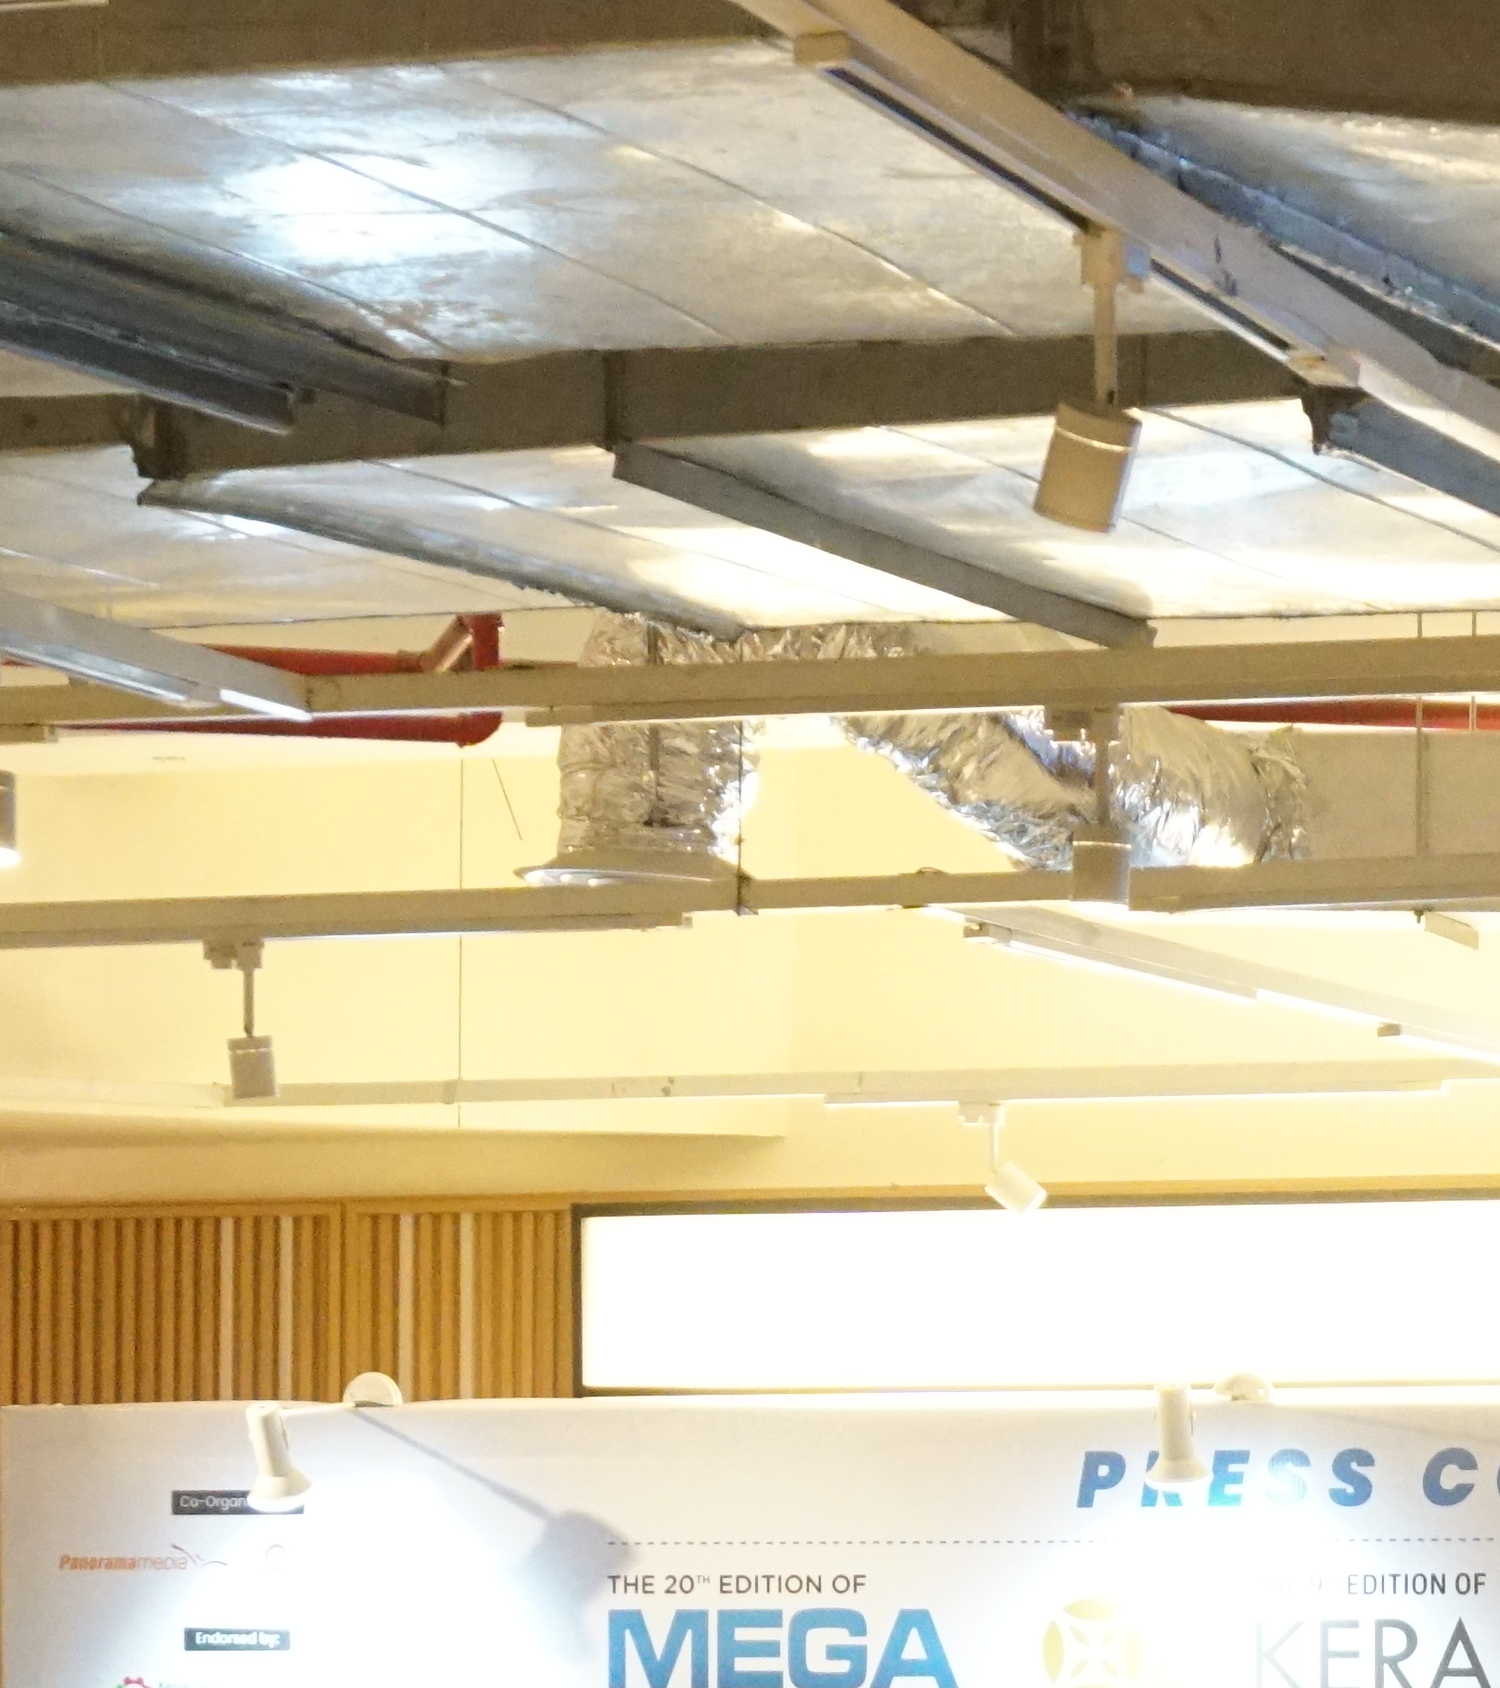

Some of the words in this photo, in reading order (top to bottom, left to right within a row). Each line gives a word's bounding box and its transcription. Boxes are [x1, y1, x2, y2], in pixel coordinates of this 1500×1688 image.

[607, 1574, 656, 1595] THE
[718, 1574, 823, 1595] EDITION
[832, 1574, 867, 1595] OF
[1346, 1572, 1447, 1596] EDITION
[1454, 1571, 1488, 1596] OF
[195, 1631, 257, 1646] Endorsed
